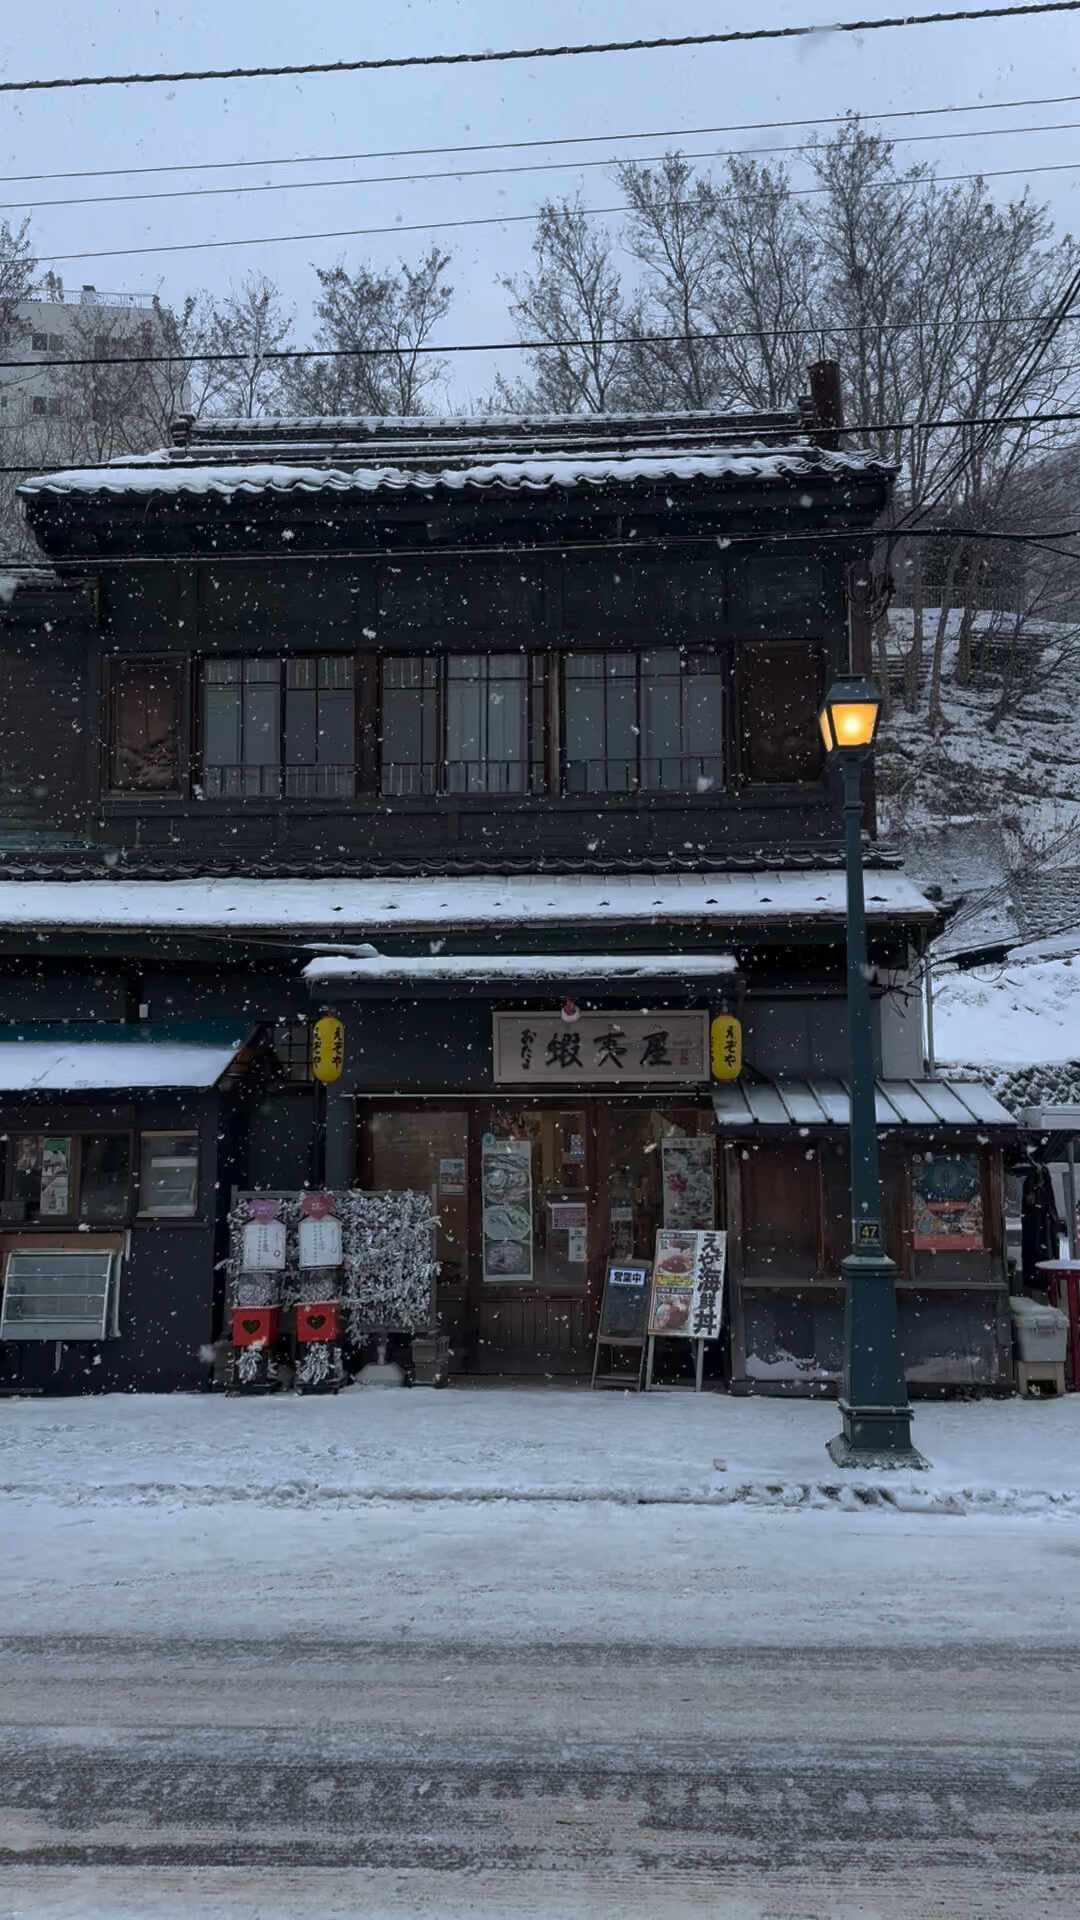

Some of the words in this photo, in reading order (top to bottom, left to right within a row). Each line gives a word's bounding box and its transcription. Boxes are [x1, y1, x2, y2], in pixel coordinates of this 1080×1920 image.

[331, 1027, 342, 1069] えぞや
[520, 1028, 537, 1070] おたる
[724, 1025, 738, 1067] えぞや
[862, 1225, 879, 1238] 47
[614, 1271, 642, 1283] 営業中
